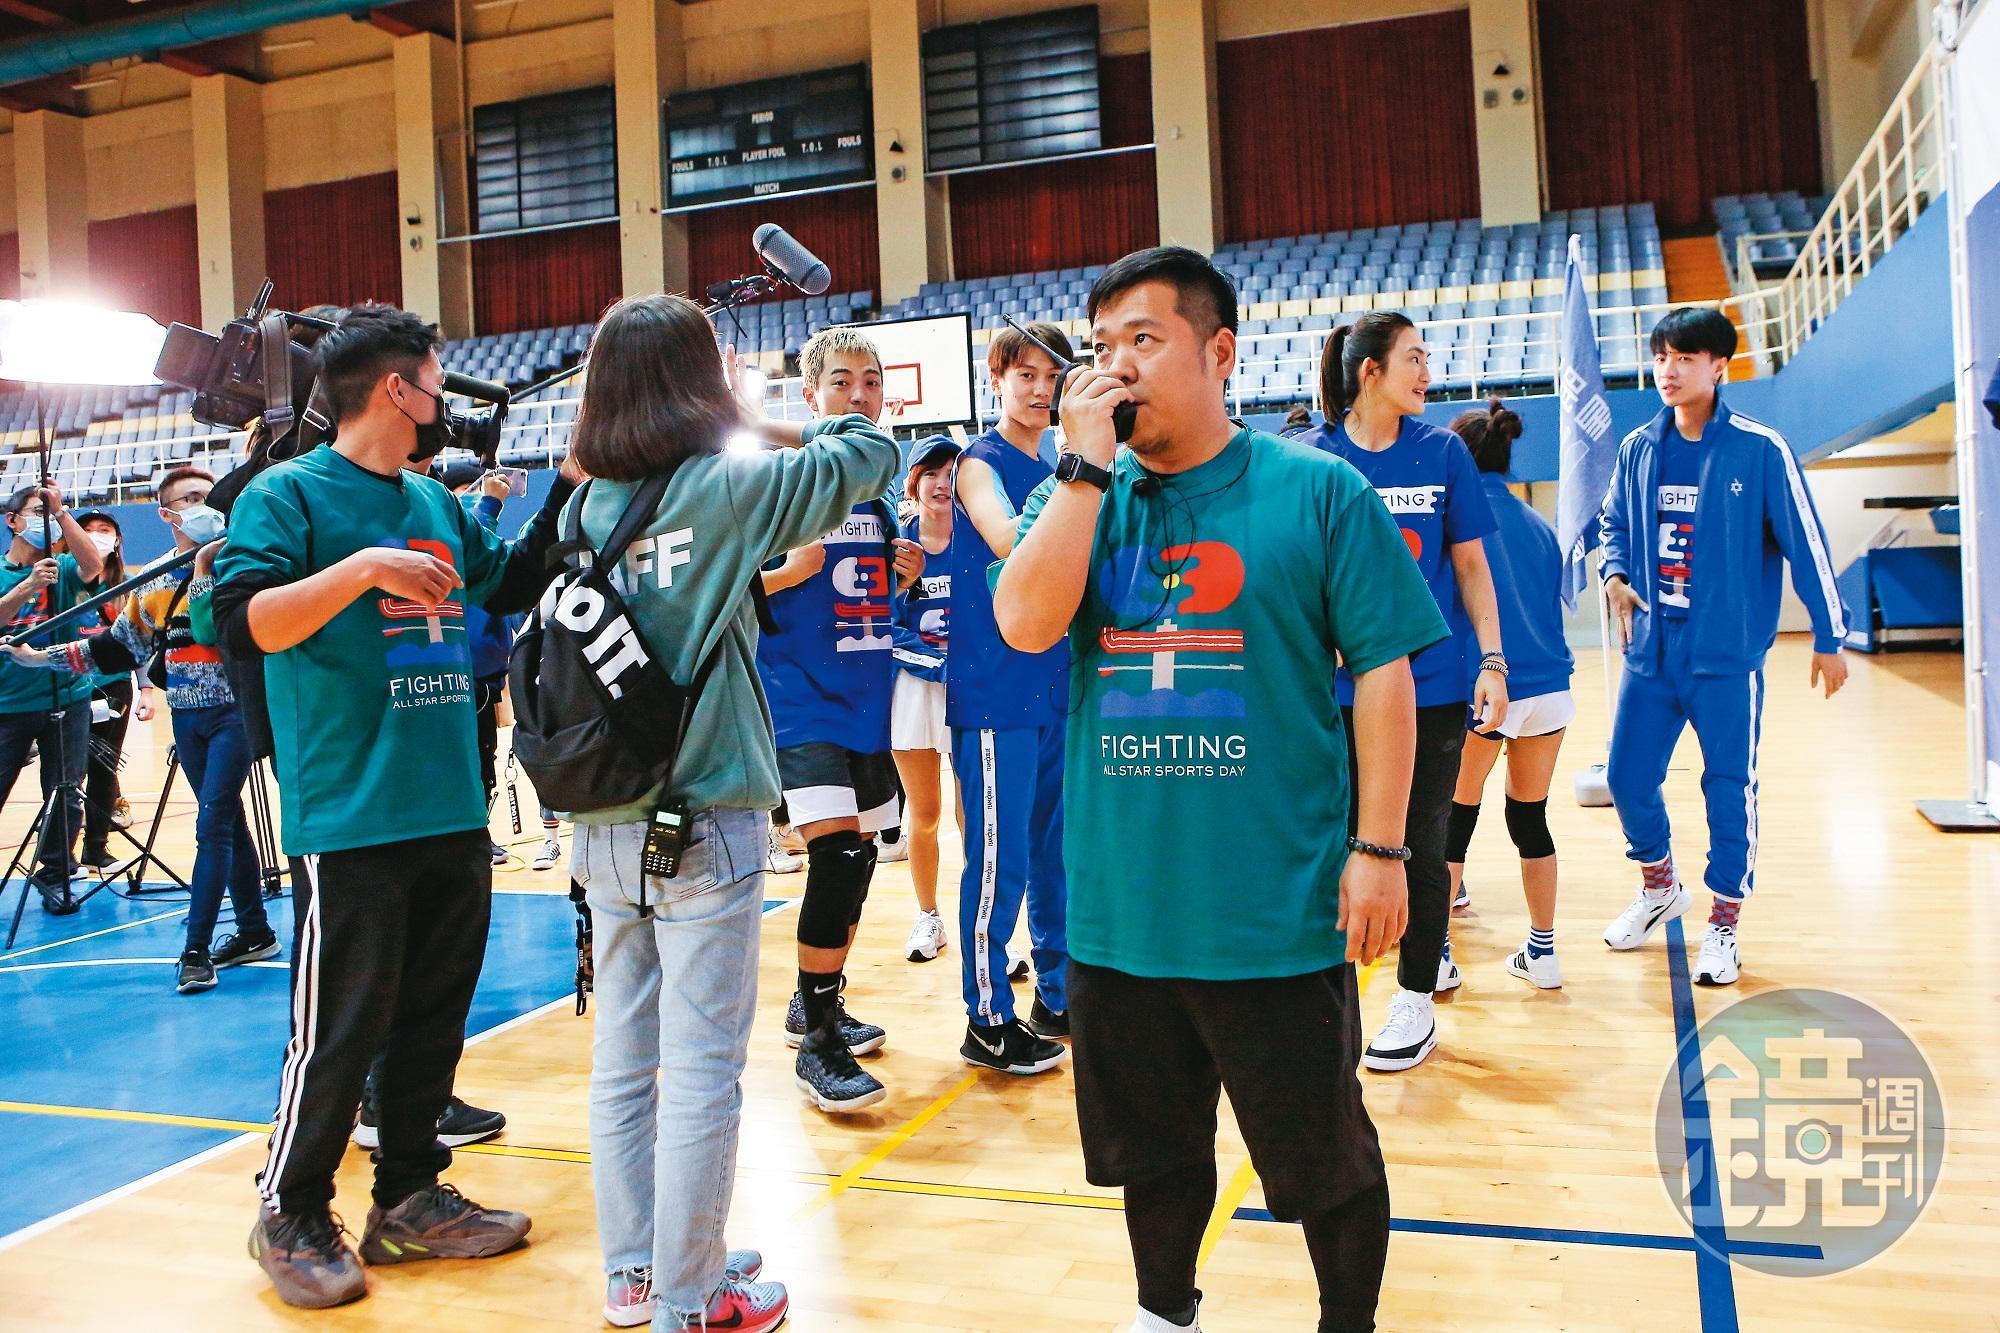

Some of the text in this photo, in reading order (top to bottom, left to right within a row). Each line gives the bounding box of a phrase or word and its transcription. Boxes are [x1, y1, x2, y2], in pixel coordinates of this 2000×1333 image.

[838, 135, 862, 148] FOULS
[742, 146, 786, 163] PLAYER FOUL
[671, 160, 694, 173] FOULS
[753, 181, 780, 195] MATCH
[389, 673, 470, 697] FIGHTING
[392, 700, 413, 709] ALL
[414, 696, 438, 707] STAR
[1101, 735, 1247, 759] FIGHTING
[1103, 764, 1246, 777] ALL STAR SPORTS DAY
